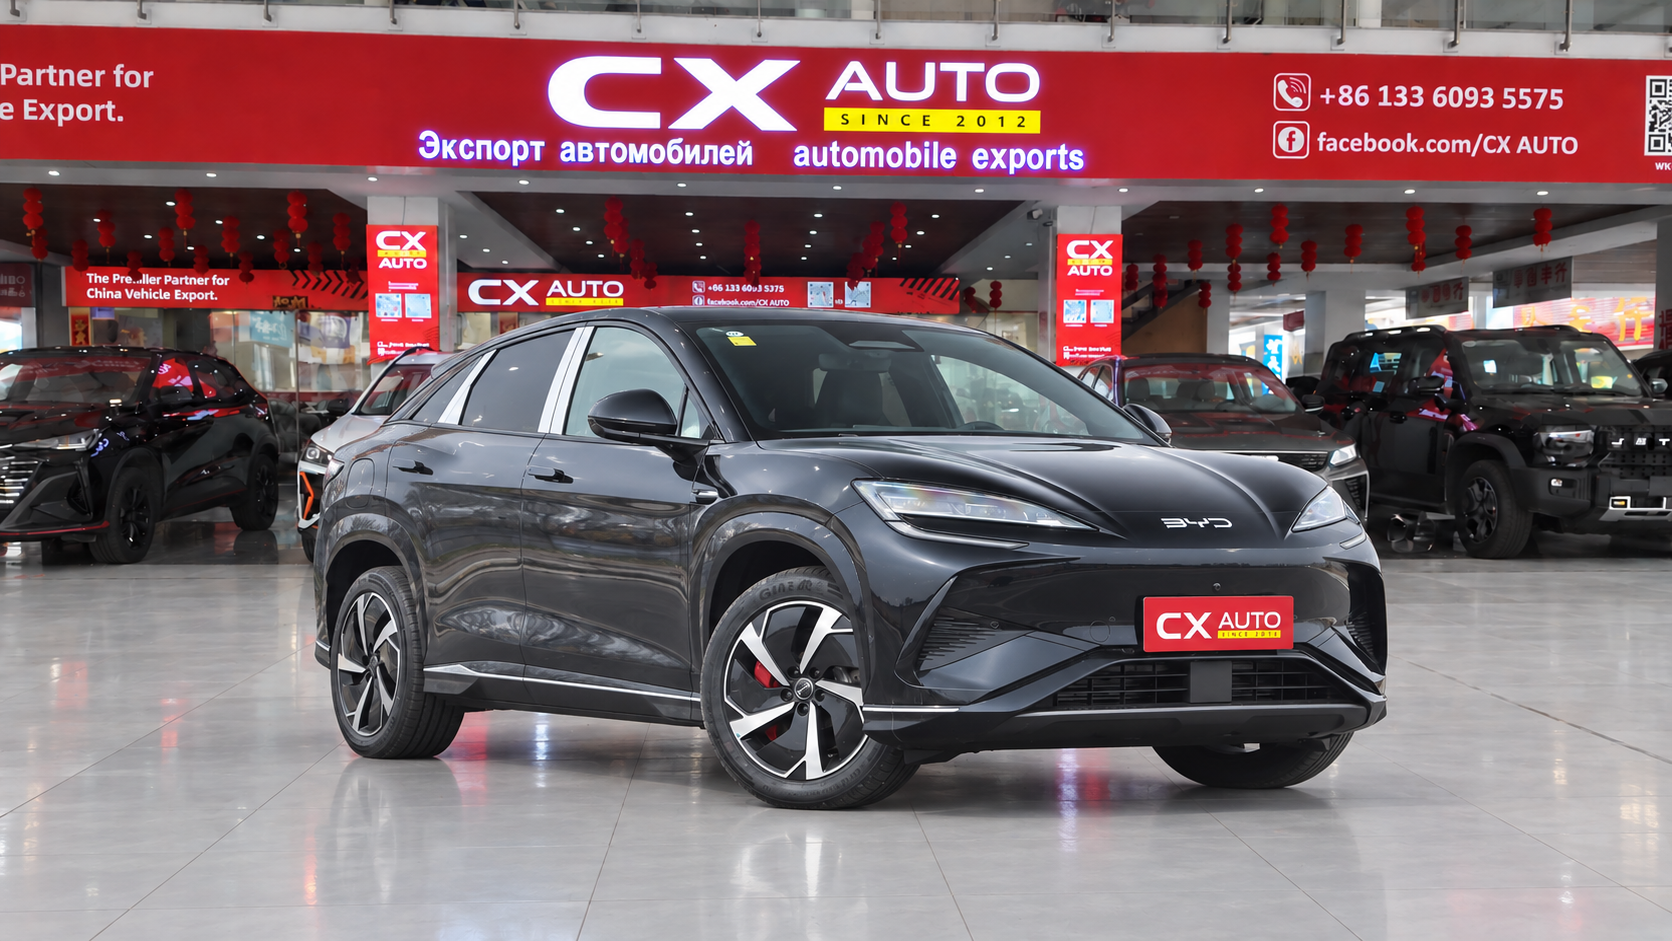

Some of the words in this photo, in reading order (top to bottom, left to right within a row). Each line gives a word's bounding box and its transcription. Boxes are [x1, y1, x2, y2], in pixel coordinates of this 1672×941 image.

[0, 63, 106, 87] Partner
[113, 64, 154, 88] for
[825, 60, 1040, 102] AUTO
[547, 55, 801, 132] CX
[1320, 85, 1370, 107] +86
[1378, 85, 1424, 107] 133
[1432, 86, 1495, 109] 6093
[1502, 88, 1564, 110] 5575
[23, 99, 124, 127] Export.
[840, 113, 932, 127] SINCE
[956, 115, 1026, 128] 2012
[418, 130, 546, 167] Экспорт
[559, 138, 753, 166] автомобилей
[793, 140, 957, 169] automobile
[972, 144, 1084, 174] exports
[1317, 132, 1514, 157] facebook.com/CX
[1516, 136, 1579, 155] AUTO
[1655, 162, 1672, 171] WK
[375, 230, 427, 250] CX
[1066, 240, 1114, 259] CX
[378, 258, 428, 269] AUTO
[1067, 265, 1113, 276] AUTO
[86, 273, 109, 284] The
[164, 274, 209, 286] Partner
[211, 274, 230, 286] for
[546, 280, 624, 297] AUTO
[725, 283, 740, 292] 133
[86, 288, 122, 299] China
[124, 288, 171, 300] Vehicle
[174, 289, 218, 303] Export.
[467, 278, 540, 306] CX
[1160, 517, 1233, 529] BYD
[1156, 612, 1212, 640] CX
[1218, 611, 1281, 629] AUTO
